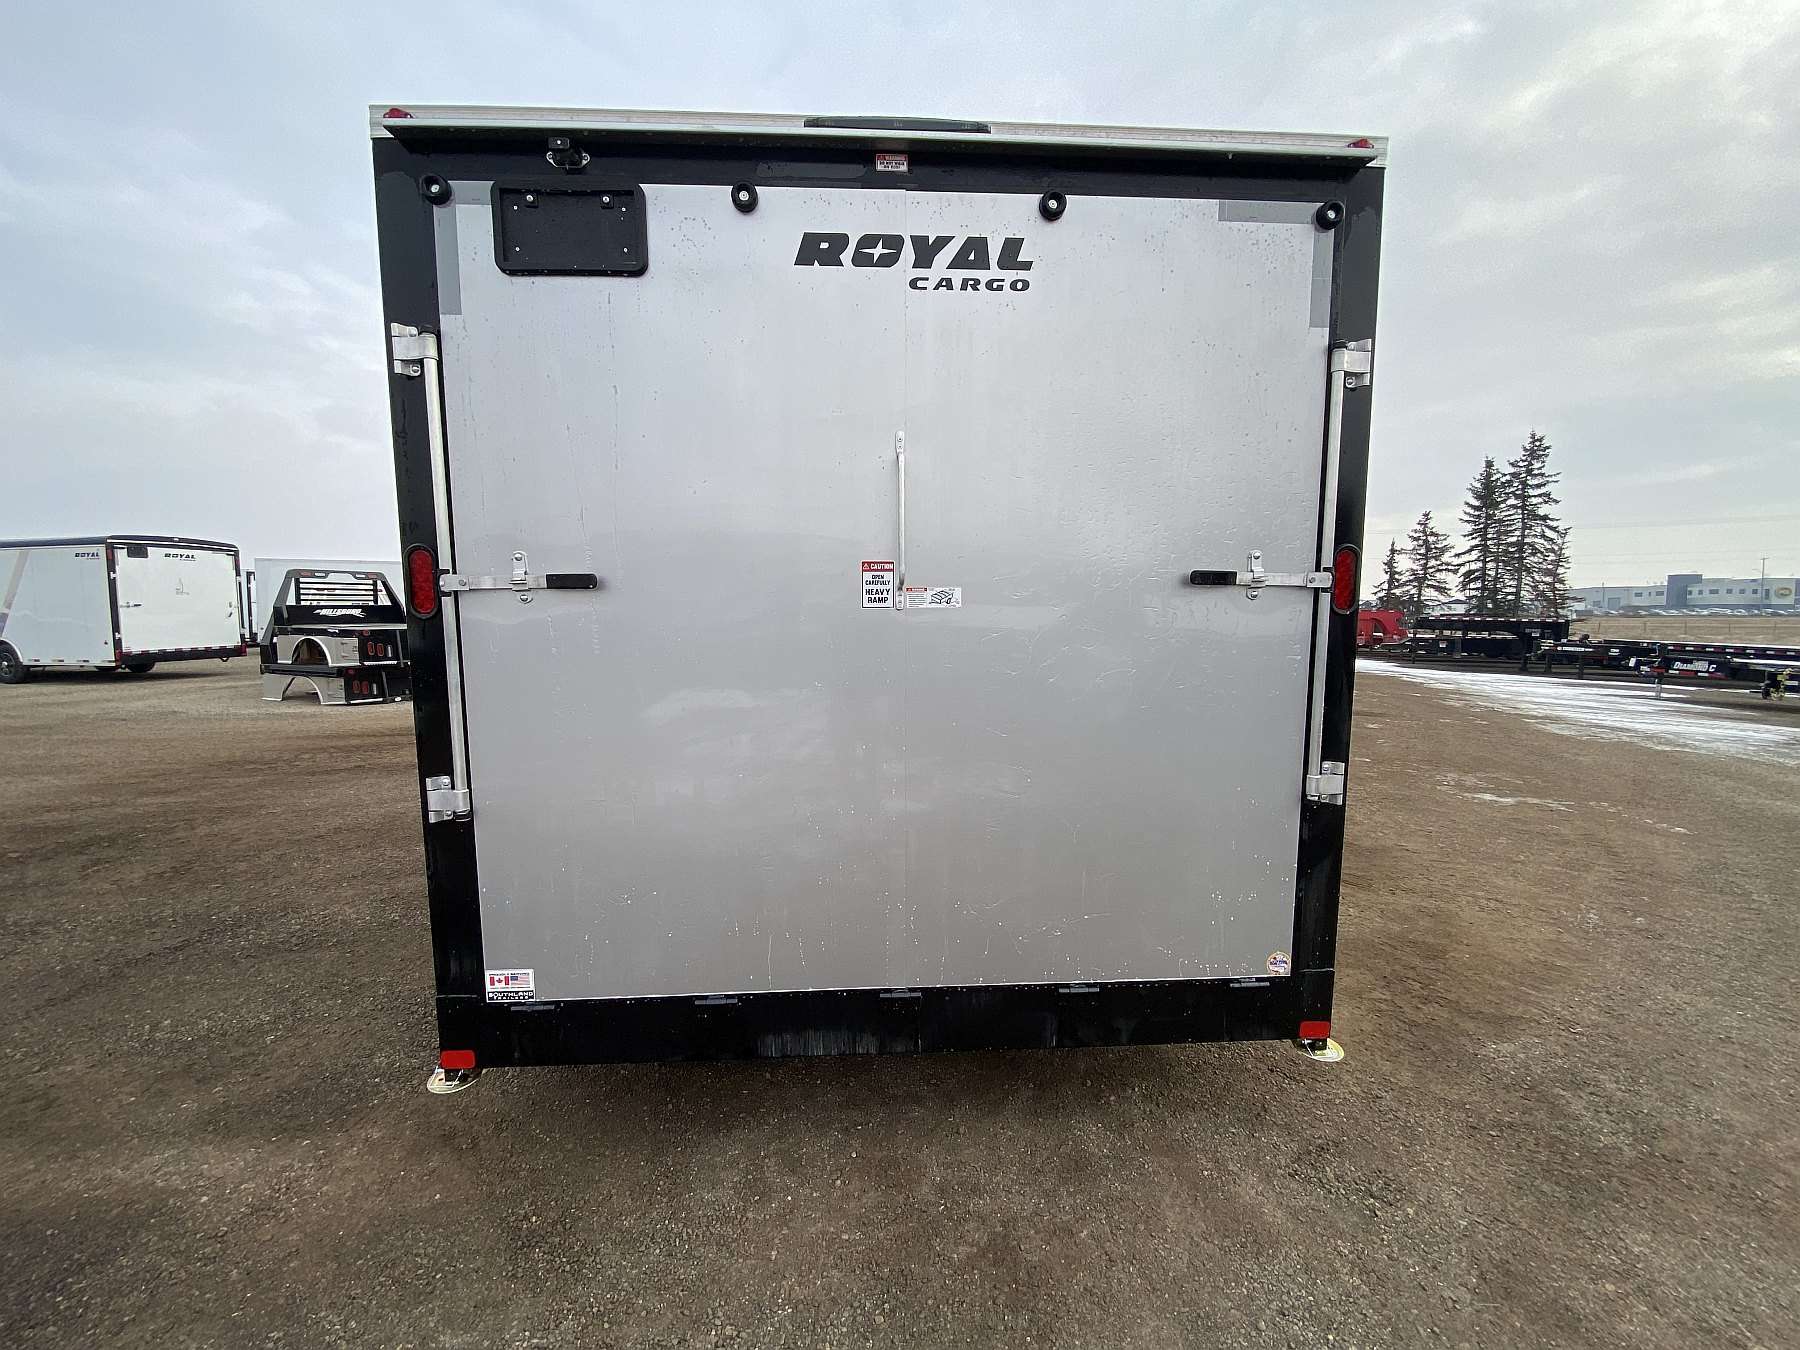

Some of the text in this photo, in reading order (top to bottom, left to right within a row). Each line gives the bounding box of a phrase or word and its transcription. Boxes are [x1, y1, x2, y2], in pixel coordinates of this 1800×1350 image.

[794, 232, 1034, 271] ROYAL
[908, 276, 1030, 292] CARGO
[865, 588, 891, 596] HEAVY
[1708, 664, 1717, 672] C
